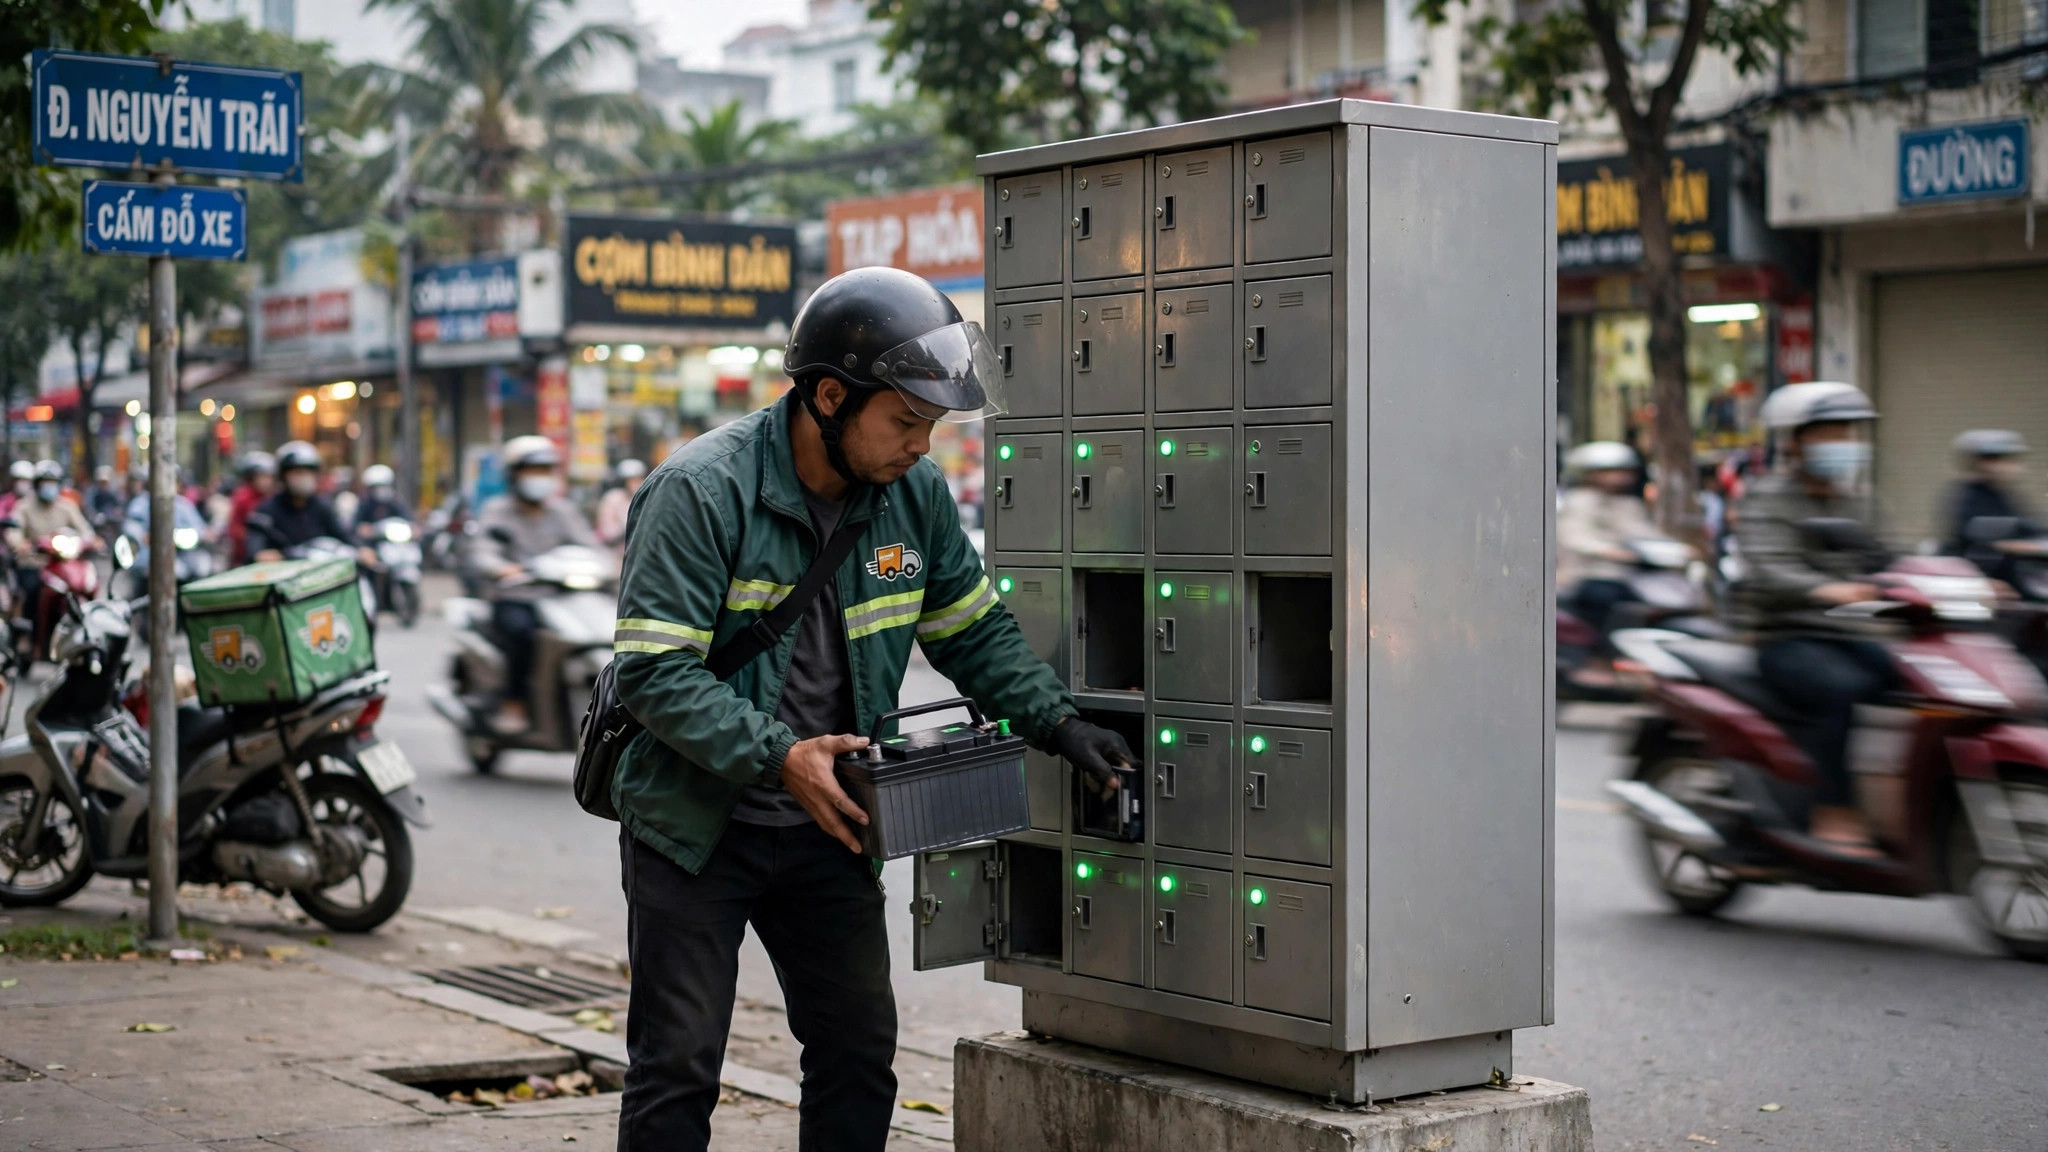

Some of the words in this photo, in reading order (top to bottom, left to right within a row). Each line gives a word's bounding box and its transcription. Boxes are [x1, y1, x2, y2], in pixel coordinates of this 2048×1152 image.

[47, 84, 78, 140] Đ.
[87, 74, 212, 150] NGUYỄN
[219, 91, 288, 156] TRÃI
[1907, 129, 2016, 196] ĐƯỜNG
[97, 189, 155, 243] CẤM
[160, 192, 196, 245] ĐỖ
[201, 208, 234, 248] XE
